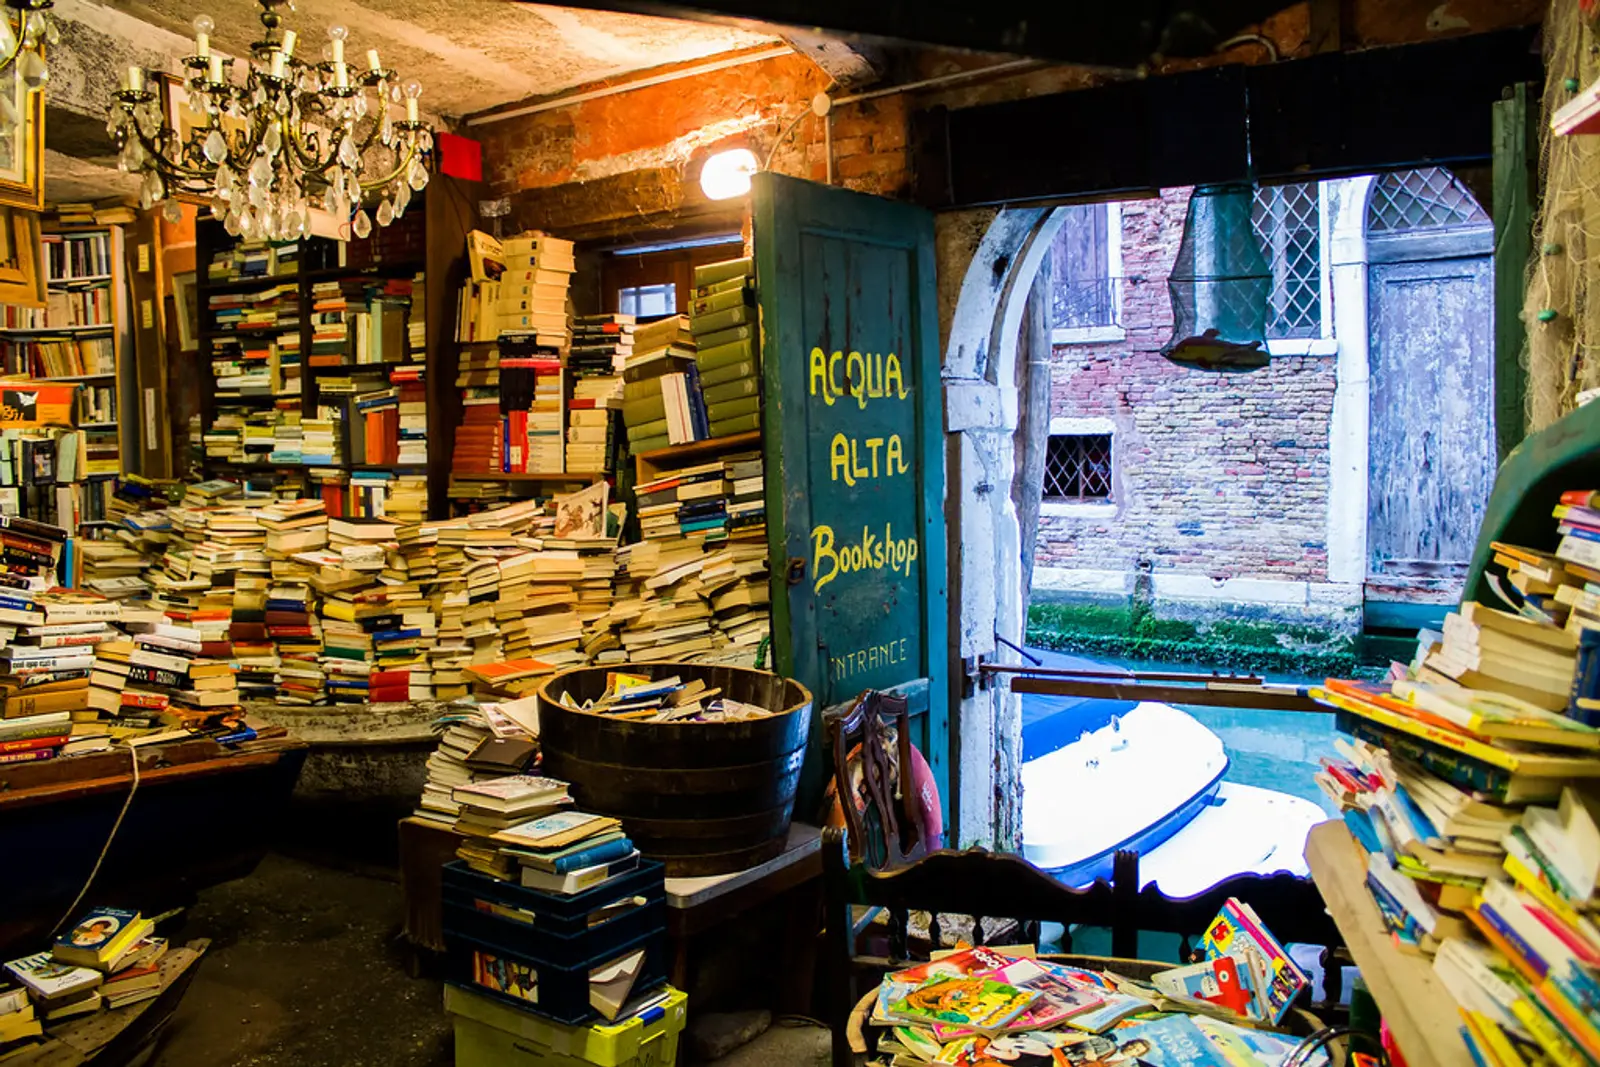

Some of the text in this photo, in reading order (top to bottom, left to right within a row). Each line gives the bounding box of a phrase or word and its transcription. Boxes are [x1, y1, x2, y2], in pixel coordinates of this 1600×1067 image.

[810, 346, 909, 410] ACQUA
[831, 433, 909, 486] ALTA
[810, 523, 919, 596] Bookshop
